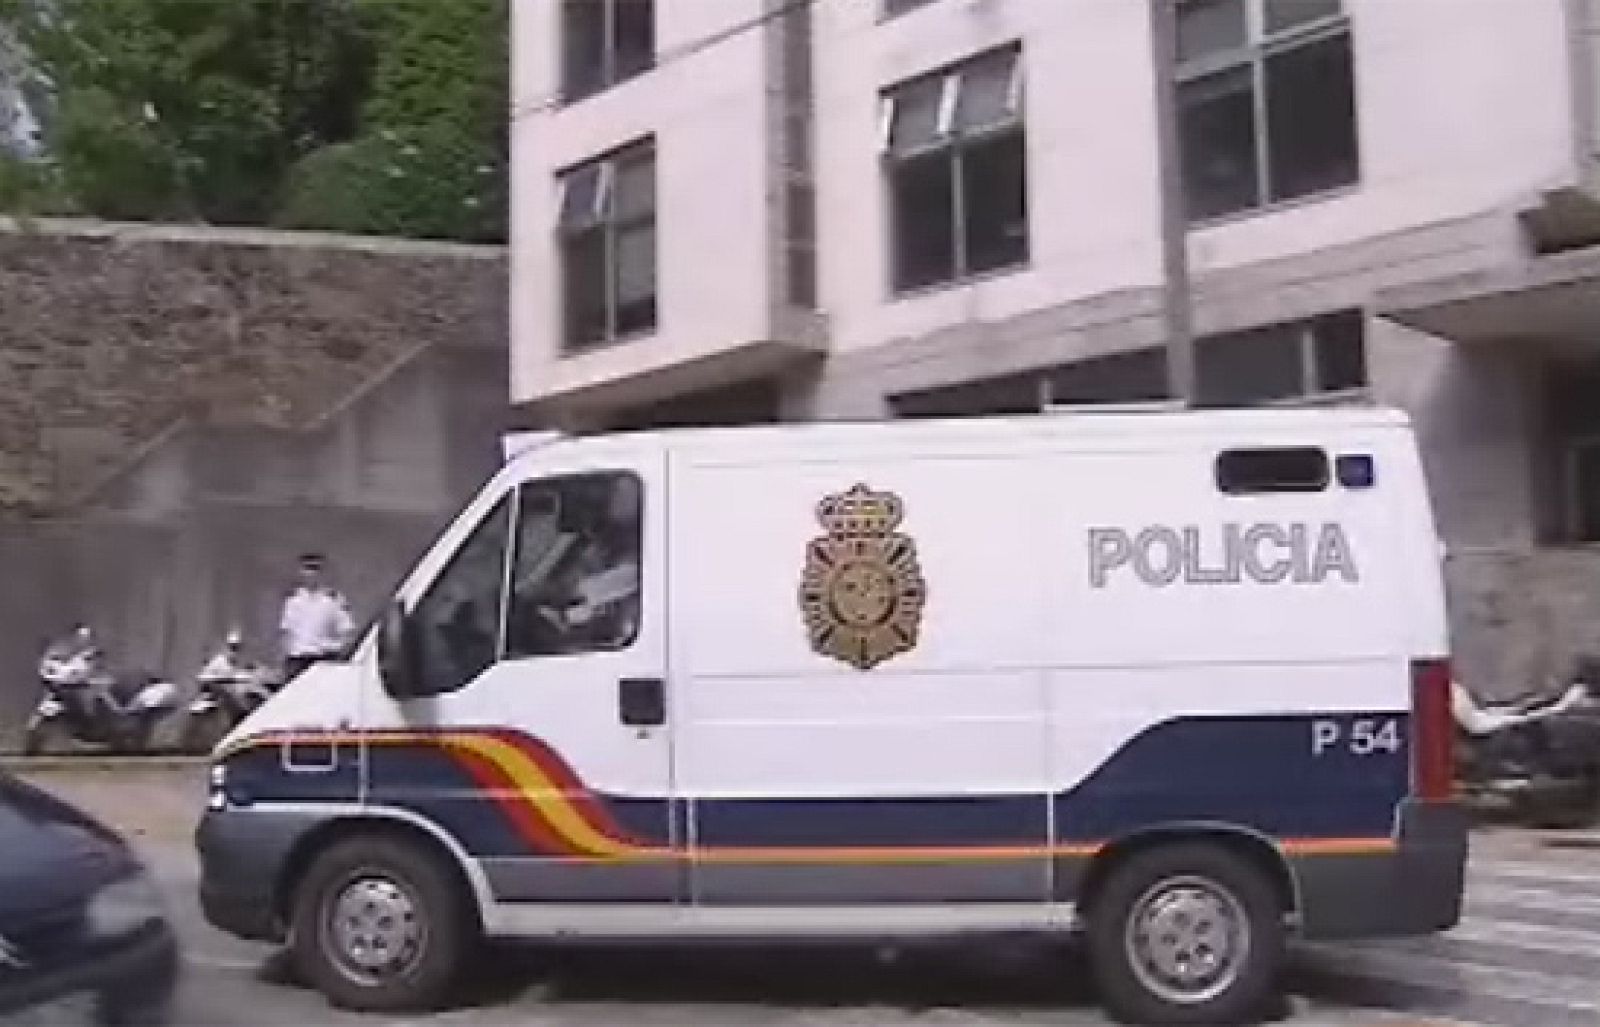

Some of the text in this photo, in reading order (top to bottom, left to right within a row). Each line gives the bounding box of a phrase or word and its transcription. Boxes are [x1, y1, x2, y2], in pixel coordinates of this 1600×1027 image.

[1088, 523, 1359, 586] POLICIA
[1312, 719, 1401, 755] P 54
